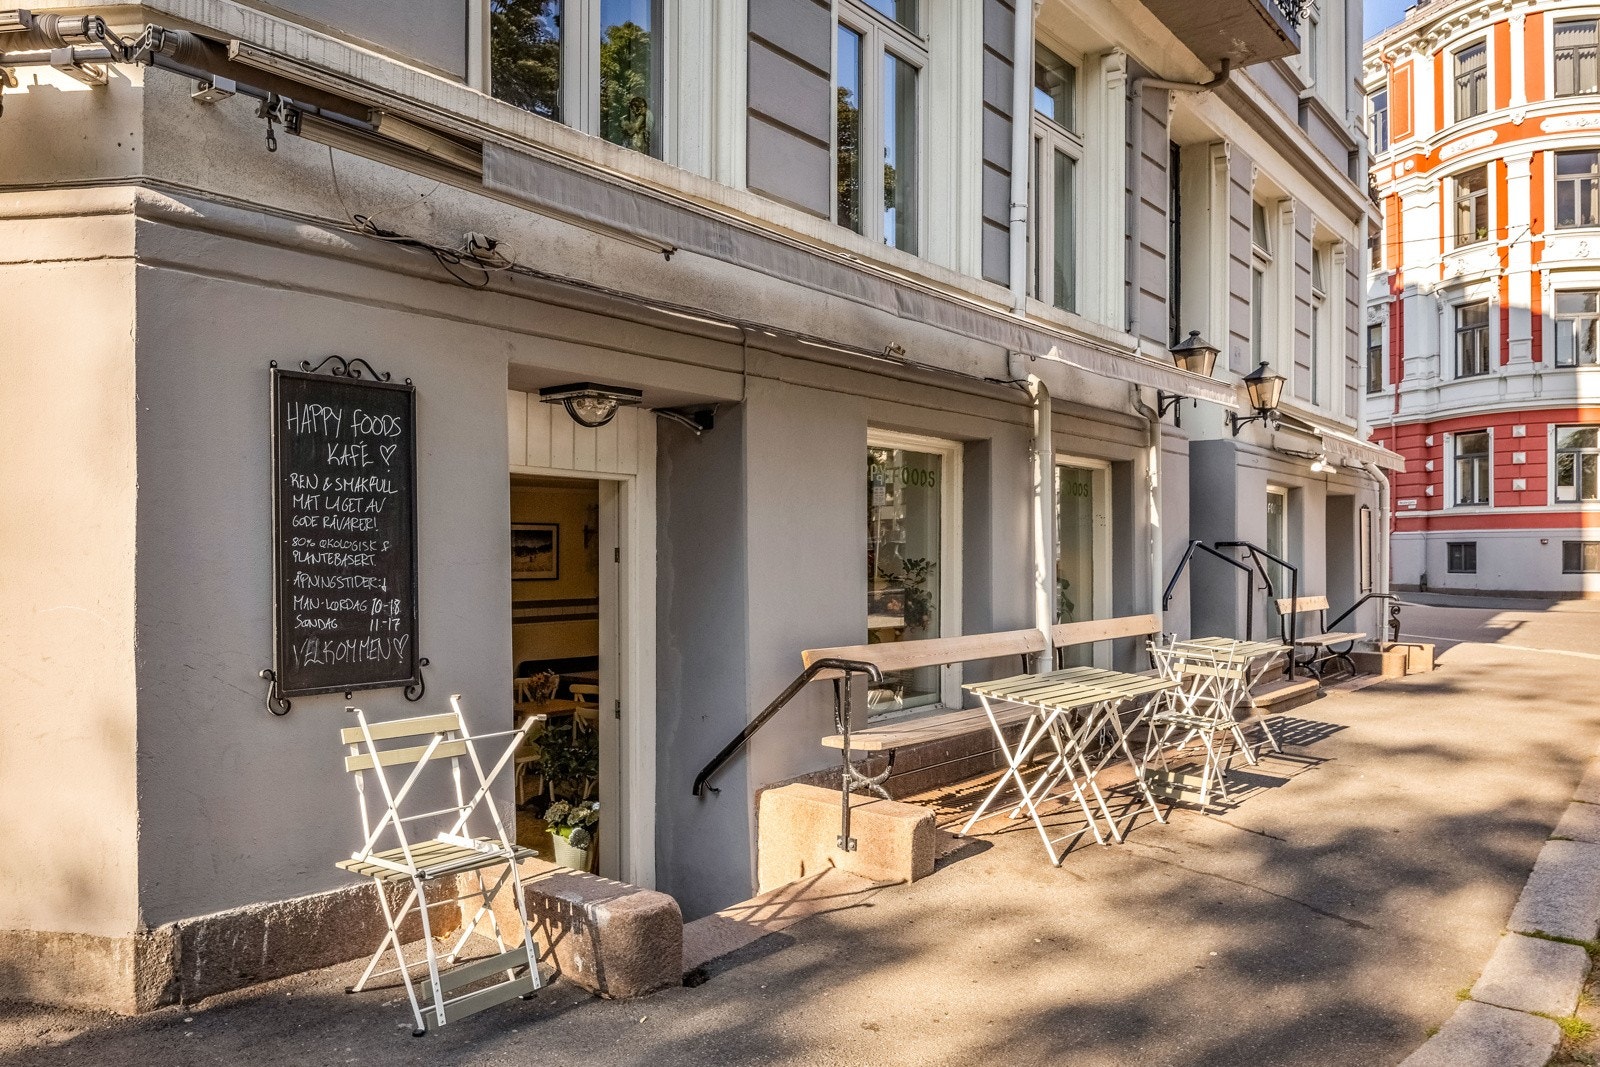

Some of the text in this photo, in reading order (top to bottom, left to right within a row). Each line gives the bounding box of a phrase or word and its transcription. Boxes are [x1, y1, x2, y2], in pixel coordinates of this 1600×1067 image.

[286, 401, 402, 439] HAPPY FOODS
[327, 440, 375, 467] KAFÉ
[289, 472, 399, 495] REN & SMAKFULL
[293, 493, 387, 513] MAT LAGET AV
[292, 514, 320, 528] GODE
[292, 536, 316, 548] 80%
[370, 597, 401, 616] 10-18
[369, 617, 401, 632] 11-17
